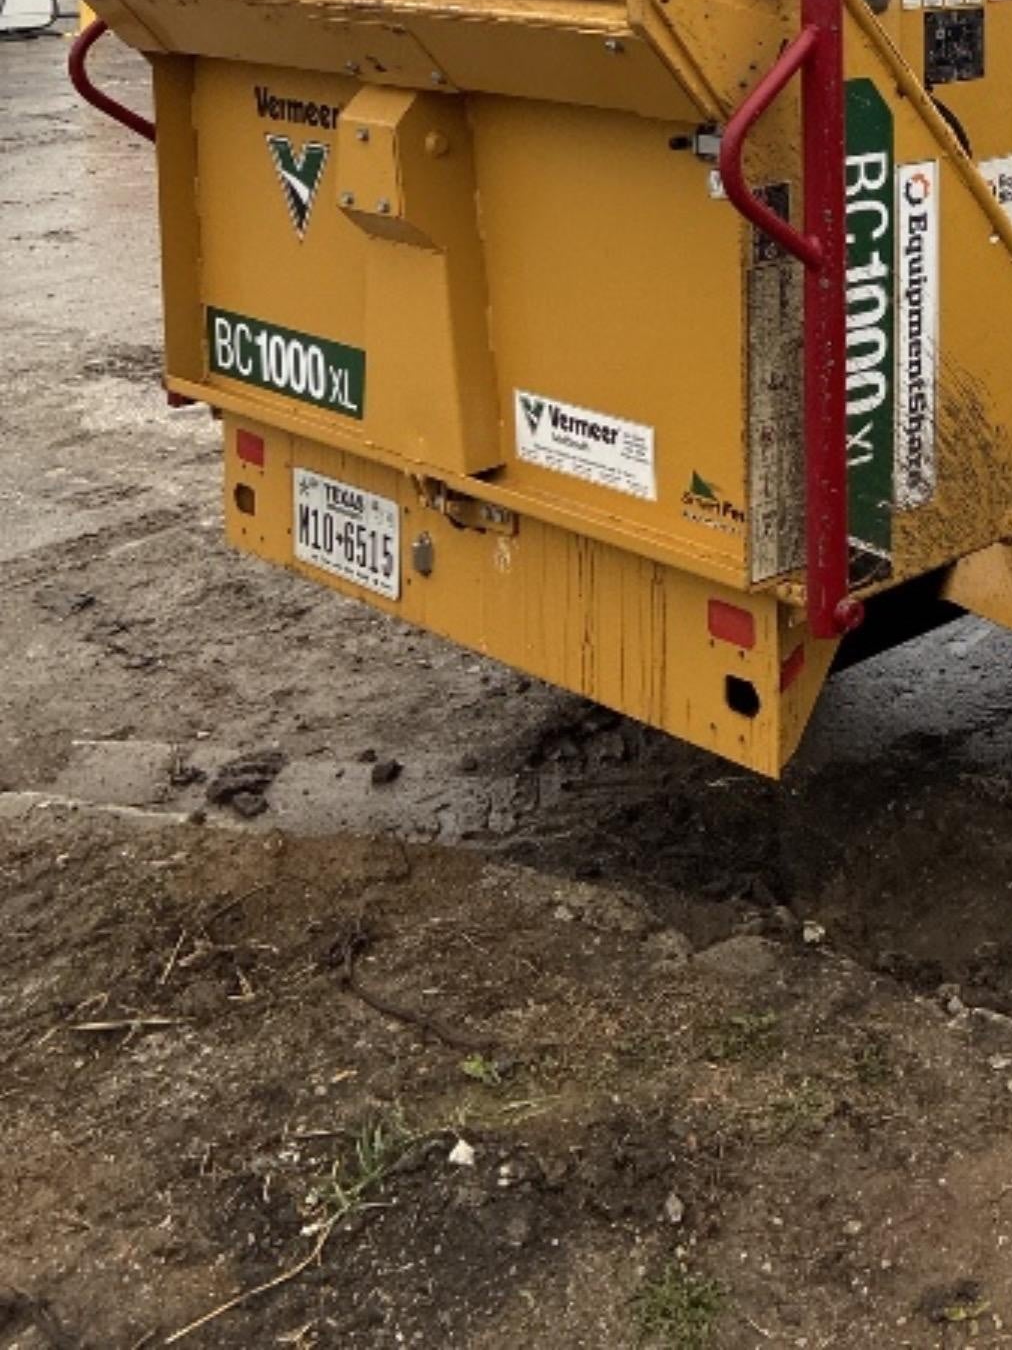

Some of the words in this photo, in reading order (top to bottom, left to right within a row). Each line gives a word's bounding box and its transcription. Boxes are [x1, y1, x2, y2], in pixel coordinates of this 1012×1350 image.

[254, 86, 340, 130] Vermeer
[548, 403, 619, 446] Vermeer
[324, 482, 364, 513] TEXAS
